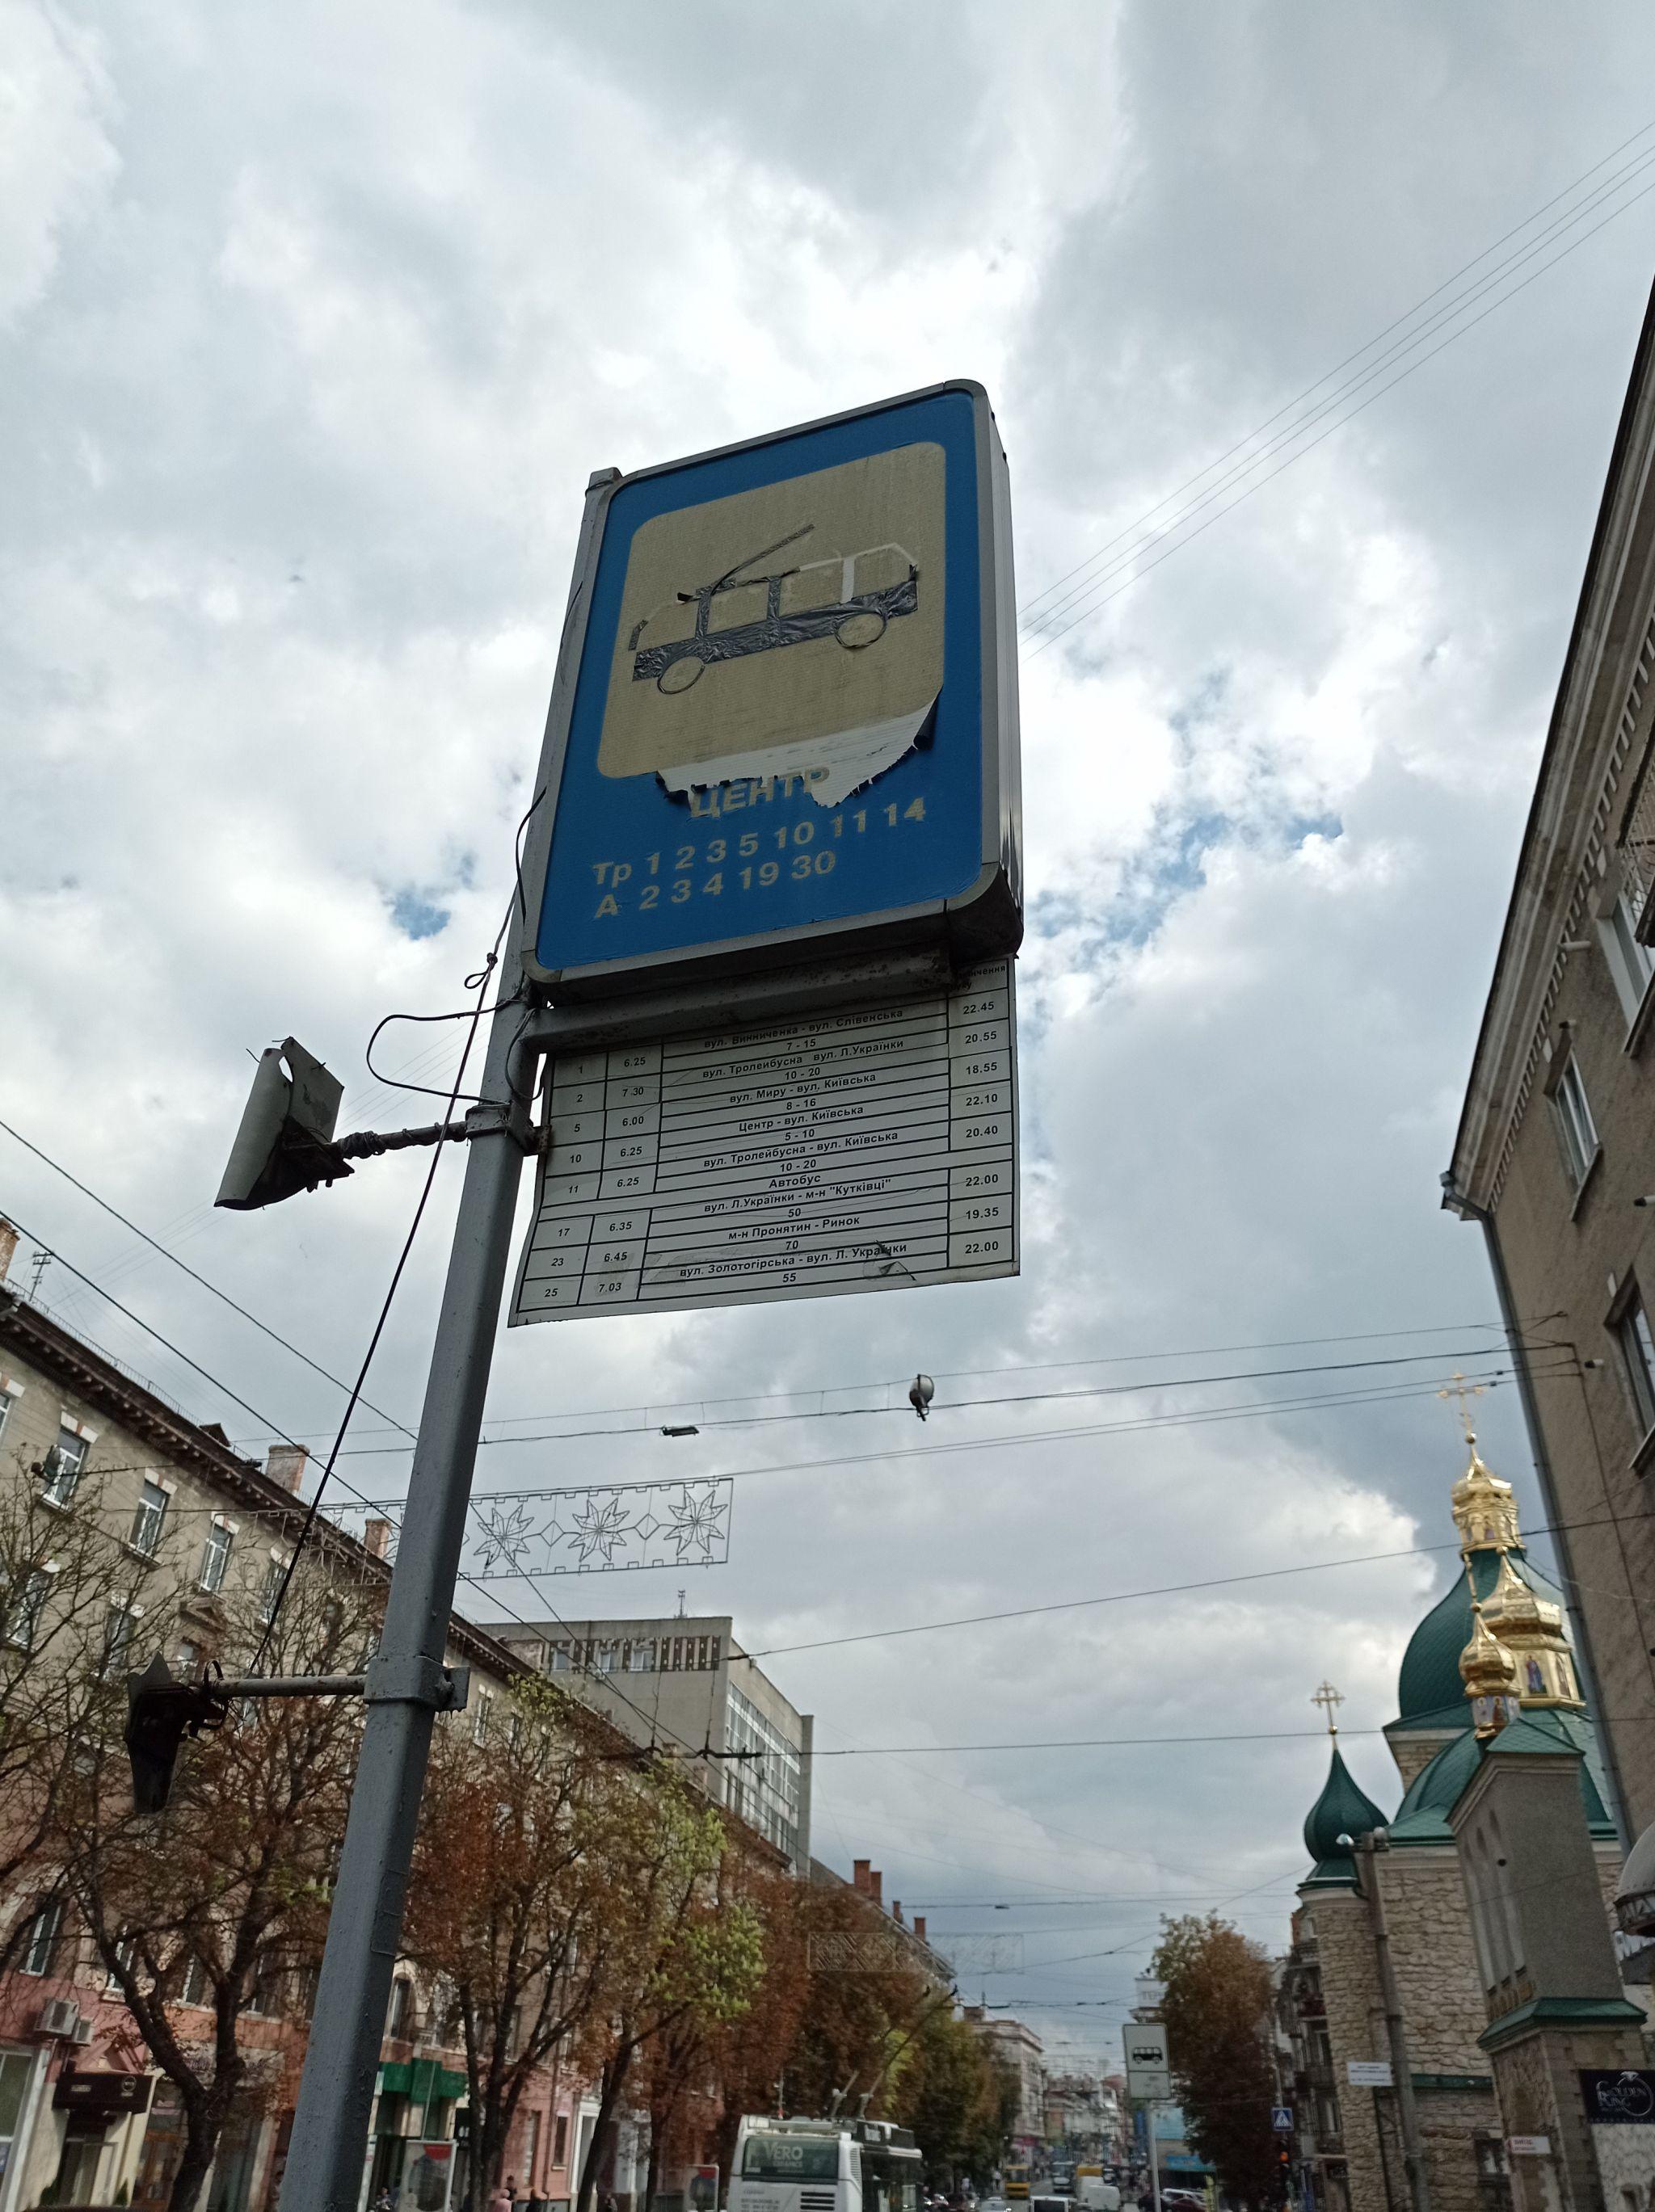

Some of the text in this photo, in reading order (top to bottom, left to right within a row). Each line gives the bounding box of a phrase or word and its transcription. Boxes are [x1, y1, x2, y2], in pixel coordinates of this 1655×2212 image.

[691, 767, 829, 818] ЦЕНТР
[592, 797, 926, 889] Тр 1 2 3 5 10 11 14
[594, 850, 836, 919] А 2 3 4 19 30
[963, 1001, 995, 1015] 22.45
[705, 1040, 727, 1049] вул.
[732, 1024, 798, 1045] Винниченка
[809, 1023, 832, 1032] вул.
[835, 1009, 903, 1027] Слівенська
[965, 1030, 997, 1045] 20.55
[786, 1041, 793, 1051] 7
[804, 1038, 816, 1048] 15
[624, 1056, 646, 1067] 6.25
[702, 1069, 726, 1079] вул.
[813, 1052, 837, 1062] вул.
[840, 1041, 903, 1057] Л.Українки
[578, 1065, 583, 1074] 1
[785, 1070, 797, 1080] 10
[808, 1066, 820, 1077] 20
[966, 1062, 997, 1074] 18.55
[730, 1094, 752, 1104] вул.
[756, 1088, 786, 1099] Миру
[797, 1083, 820, 1094] вул.
[824, 1074, 876, 1088] Київська
[576, 1094, 583, 1103] 2
[786, 1101, 793, 1111] 8
[803, 1098, 816, 1108] 16
[966, 1093, 998, 1107] 22.10
[622, 1116, 644, 1126] 6.00
[739, 1121, 773, 1133] Центр
[784, 1116, 808, 1126] вул.
[812, 1107, 863, 1121] Київська
[574, 1123, 580, 1133] 5
[966, 1125, 998, 1138] 20.40
[785, 1132, 791, 1141] 5
[802, 1129, 815, 1138] 10
[620, 1146, 642, 1157] 6.25
[704, 1158, 726, 1168] вул.
[731, 1146, 806, 1164] Тролейбусна
[817, 1142, 841, 1152] вул.
[845, 1133, 898, 1146] Київська
[570, 1154, 582, 1163] 10
[780, 1163, 793, 1172] 10
[802, 1159, 816, 1169] 20
[617, 1176, 639, 1188] 6.25
[769, 1174, 821, 1188] Автобус
[965, 1174, 999, 1187] 22.00
[568, 1185, 579, 1194] 11
[704, 1203, 728, 1213] вул.
[731, 1192, 794, 1209] Л.Українки
[806, 1189, 826, 1199] м-н
[830, 1179, 891, 1196] "Кутківці"
[787, 1208, 802, 1217] 50
[966, 1206, 999, 1220] 19.35
[558, 1227, 571, 1237] 17
[609, 1221, 633, 1232] 6.35
[728, 1231, 748, 1240] м-н
[752, 1223, 811, 1238] Пронятин
[823, 1217, 860, 1229] Ринок
[785, 1240, 798, 1251] 70
[965, 1241, 999, 1254] 22.00
[550, 1257, 564, 1267] 23
[604, 1251, 628, 1263] 6.45
[680, 1267, 704, 1278] вул.
[708, 1256, 795, 1274] Золотогірська
[806, 1253, 832, 1264] вул.
[836, 1249, 848, 1259] Л.
[782, 1272, 797, 1283] 55
[544, 1288, 558, 1297] 25
[599, 1282, 622, 1293] 7.03
